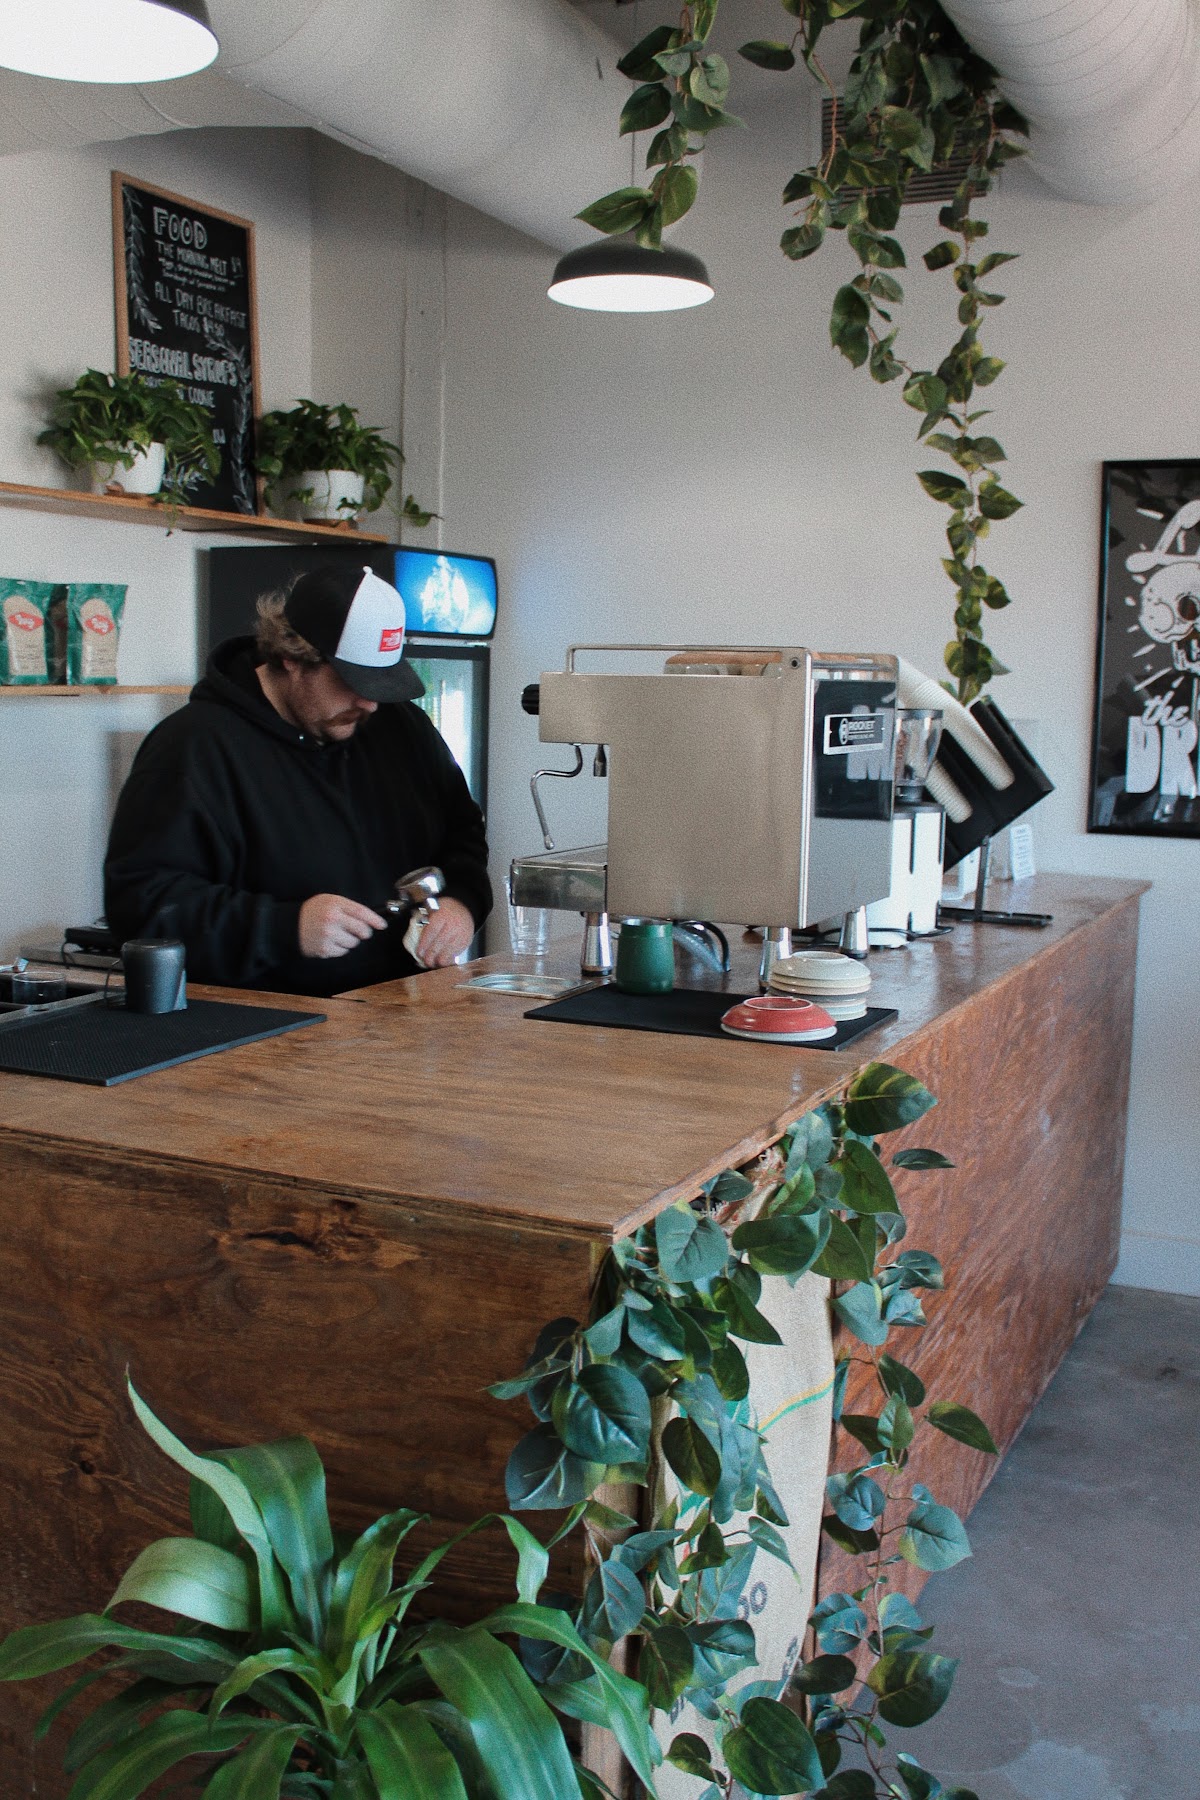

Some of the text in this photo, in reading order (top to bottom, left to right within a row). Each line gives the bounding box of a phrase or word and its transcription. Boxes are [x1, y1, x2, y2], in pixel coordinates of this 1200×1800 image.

[153, 206, 208, 250] FOOD
[155, 240, 175, 259] THE
[154, 281, 246, 330] ALL DAY BREAKFAST
[172, 309, 200, 334] TACOS
[128, 336, 237, 387] SEASONAL SYRUPS
[849, 720, 876, 731] ROCKET
[1144, 690, 1190, 727] the
[1125, 716, 1200, 798] DR
